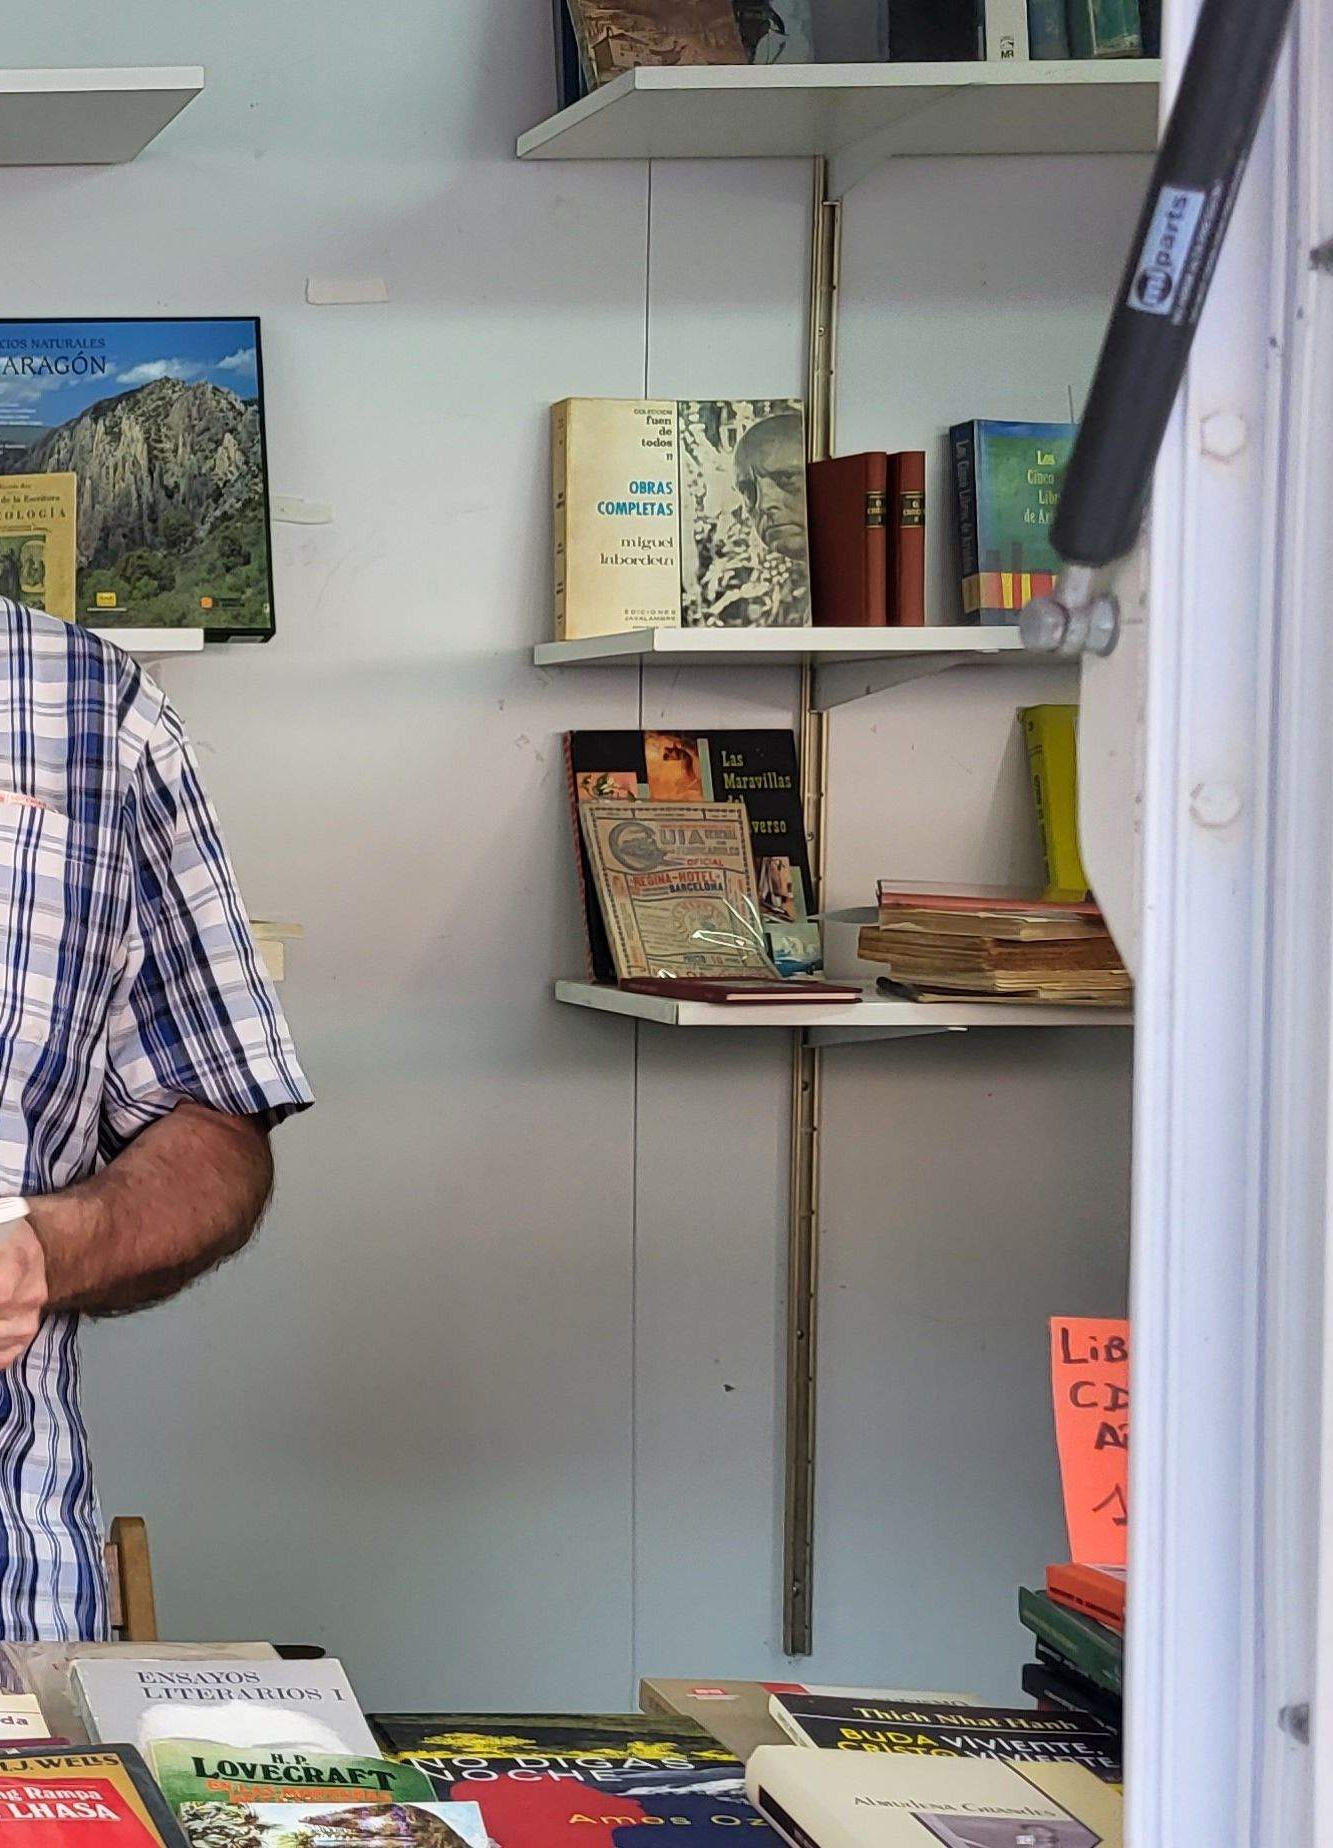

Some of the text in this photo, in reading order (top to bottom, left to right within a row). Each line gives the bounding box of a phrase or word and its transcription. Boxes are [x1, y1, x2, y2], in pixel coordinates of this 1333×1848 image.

[31, 338, 107, 349] NATURALES
[1, 350, 107, 376] ARAGÓN
[645, 415, 672, 426] fuen
[658, 426, 673, 437] de
[640, 437, 673, 448] todos
[1037, 449, 1056, 466] Los
[1026, 469, 1055, 486] Cinco
[628, 480, 674, 495] OBRAS
[596, 500, 674, 517] COMPLETAS
[1024, 508, 1036, 524] de
[620, 536, 674, 550] miguel
[599, 552, 674, 566] labordeta
[721, 750, 744, 767] Las
[722, 772, 792, 790] Maravillas
[686, 857, 724, 867] OFICIAL
[668, 881, 724, 894] BARCELONA
[136, 1670, 261, 1685] ENSAYOS
[139, 1686, 323, 1701] LITERARIOS
[852, 1706, 1079, 1732] Thich Nhat Hanh
[838, 1727, 939, 1748] BUDA
[270, 1753, 288, 1765] H.
[517, 1757, 697, 1771] DIGAS
[191, 1755, 397, 1792] LOVECRAFT
[420, 1768, 624, 1783] NOCHE
[25, 1784, 103, 1804] Rampa
[7, 1798, 121, 1822] LHASA
[853, 1795, 1057, 1819] Almudena Grandes
[568, 1812, 694, 1826] Amos
